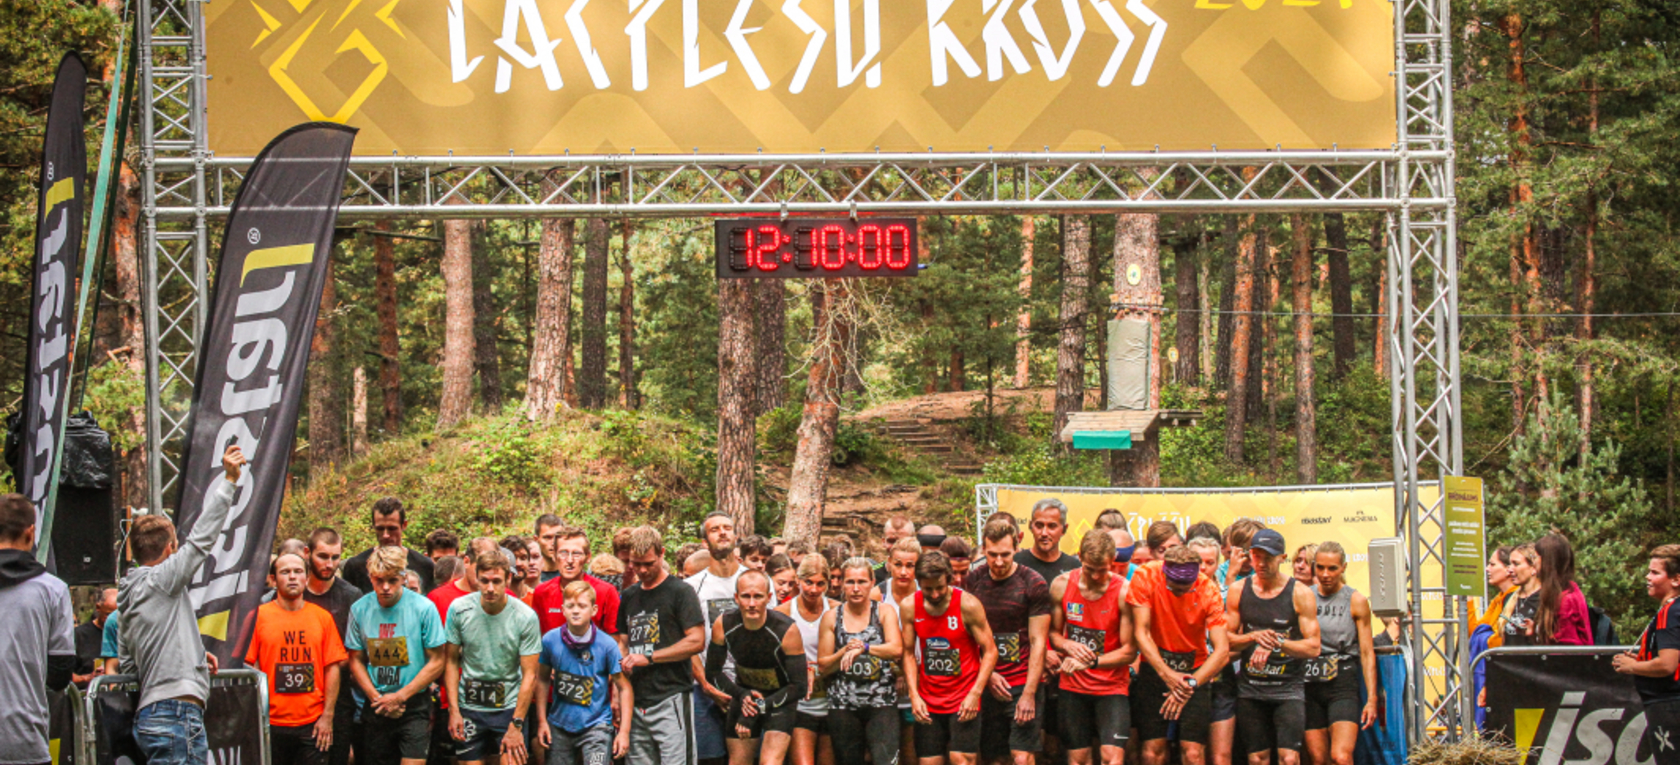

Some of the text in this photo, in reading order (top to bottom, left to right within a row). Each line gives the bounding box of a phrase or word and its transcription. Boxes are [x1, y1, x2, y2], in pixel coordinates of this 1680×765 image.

[745, 224, 910, 271] 12:10:00
[284, 631, 306, 645] WE
[630, 624, 650, 642] 277
[280, 647, 311, 662] RUN
[374, 648, 400, 660] 444
[928, 658, 954, 672] 202
[285, 673, 304, 688] 39
[468, 689, 497, 703] 214
[558, 681, 584, 700] 272
